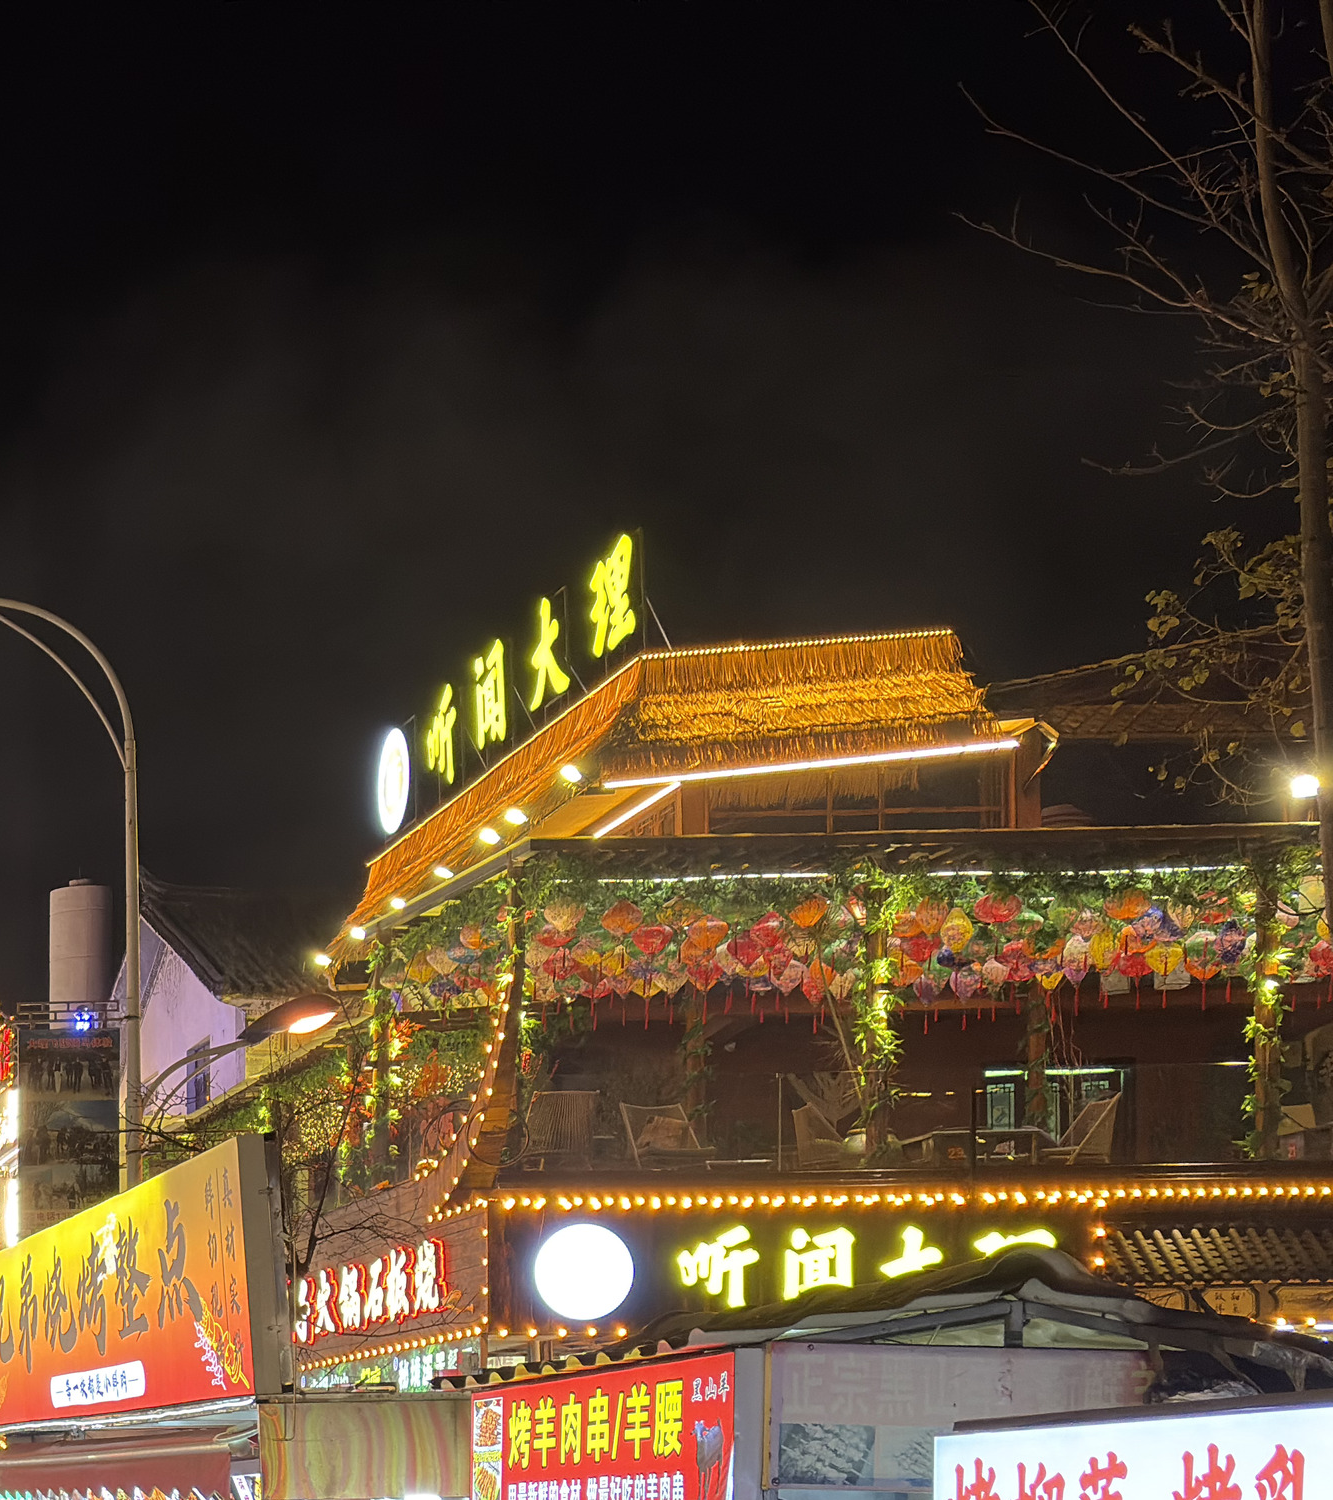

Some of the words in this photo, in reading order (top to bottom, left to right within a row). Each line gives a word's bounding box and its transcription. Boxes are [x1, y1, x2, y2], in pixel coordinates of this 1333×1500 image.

[425, 533, 635, 784] 听闻大理
[676, 1225, 1057, 1308] 听闻大
[508, 1379, 684, 1470] 烤羊肉串/羊腰
[691, 1370, 730, 1403] 黑山羊
